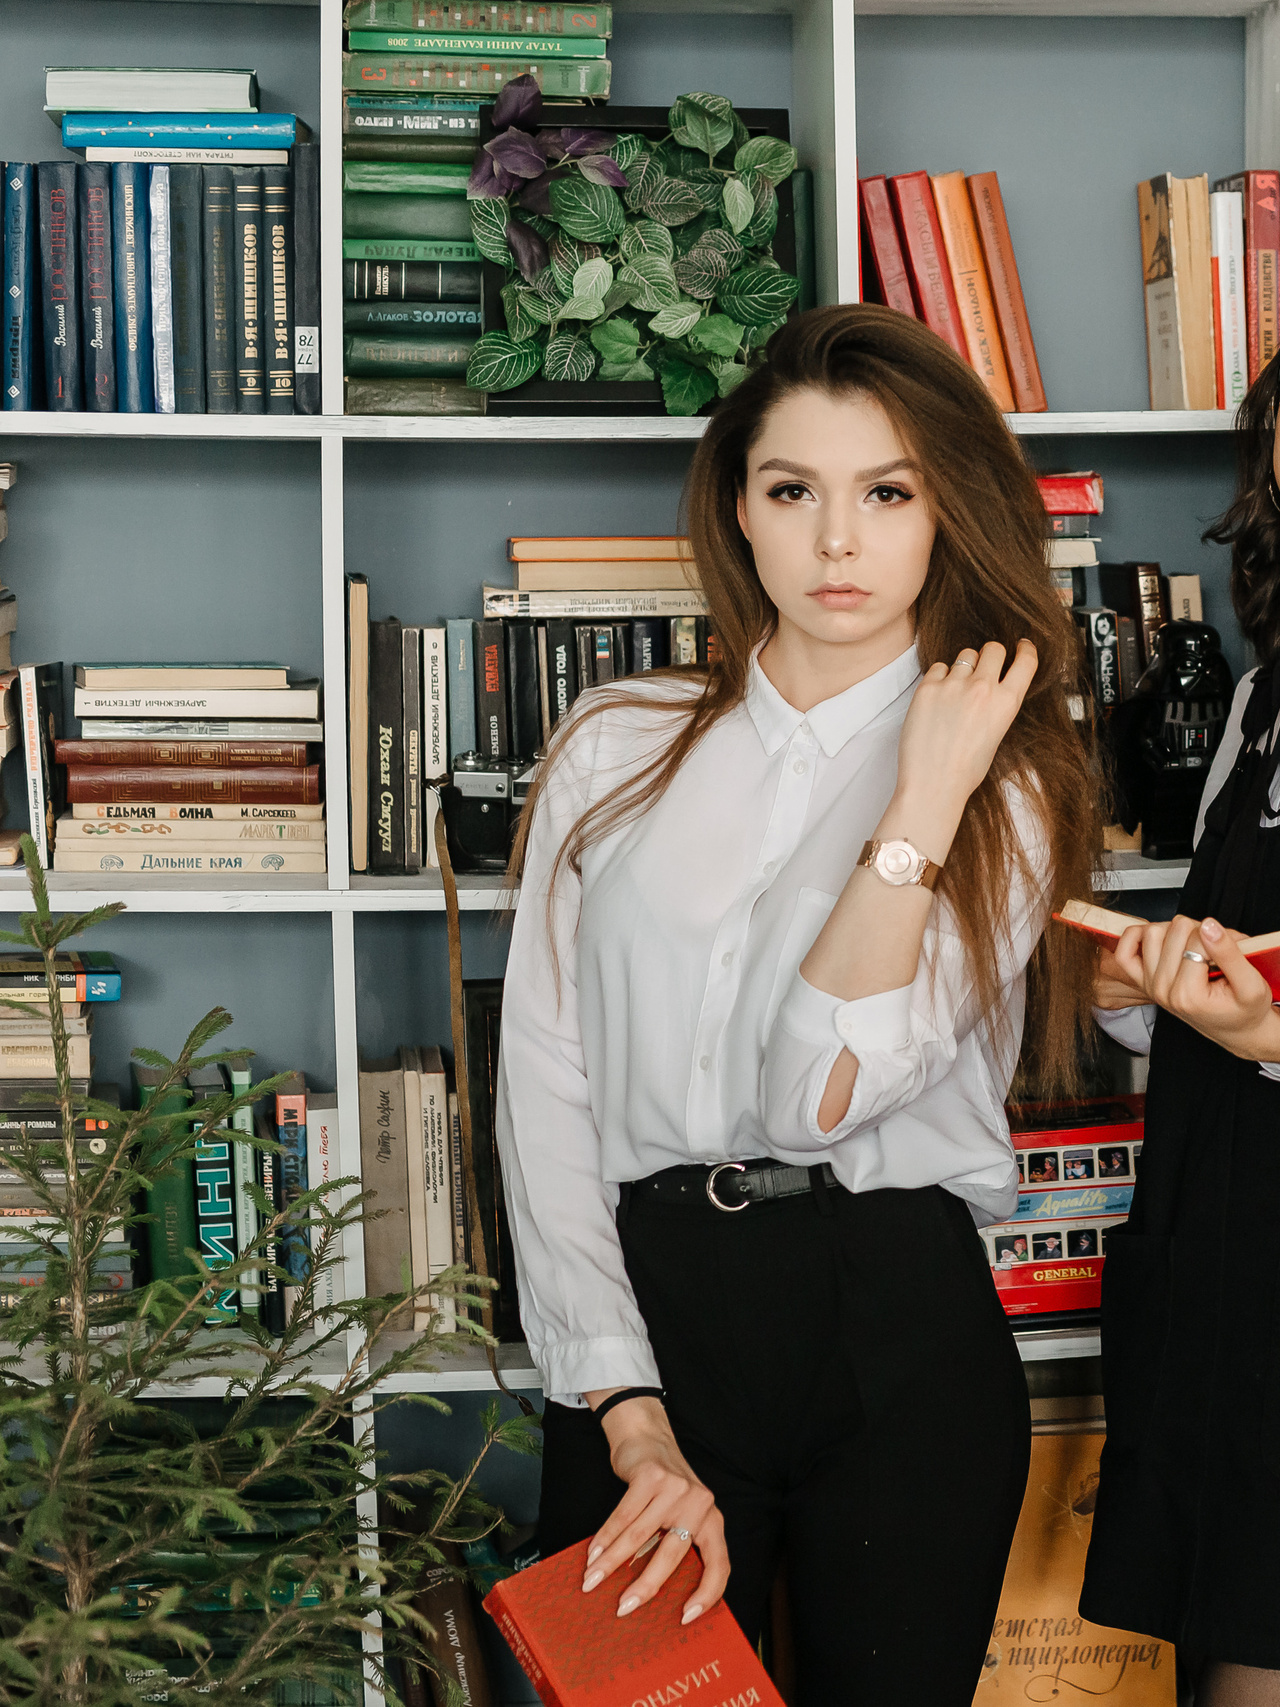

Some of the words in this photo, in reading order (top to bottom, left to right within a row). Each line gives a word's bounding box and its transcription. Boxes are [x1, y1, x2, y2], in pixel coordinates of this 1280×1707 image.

[387, 37, 408, 47] 2008
[414, 38, 483, 50] КАЛЕНДАРЕ
[486, 40, 523, 51] ДИНИ
[526, 41, 562, 52] ТАТАР
[126, 252, 137, 313] ЭДМУНДОВИЧ
[965, 277, 986, 334] ЛОНДОН
[53, 304, 66, 347] Василий
[89, 306, 103, 350] Василий
[127, 315, 138, 352] ФЕЛИКС
[298, 334, 314, 347] 78
[297, 353, 313, 365] 77
[979, 338, 995, 377] ДЖЕК
[275, 377, 291, 388] 10
[556, 644, 567, 675] ГОДА
[431, 655, 440, 701] ДЕТЕКТИВ
[94, 699, 141, 709] ДЕТЕКТИВ
[145, 699, 207, 708] ЗАРУБЕЖНЫЙ
[432, 703, 440, 765] ЗАРУБЕЖНЫЙ
[489, 714, 500, 756] ЕМЕНОВ
[379, 725, 394, 787] Юхан
[96, 806, 156, 819] СЕДЬМАЯ
[169, 806, 214, 820] ВОЛНА
[377, 791, 394, 853] Смуул
[209, 856, 243, 869] КРАЯ
[28, 1121, 56, 1129] РОМАНЫ
[283, 1108, 299, 1149] МЕРИ
[1033, 1266, 1097, 1281] GENERAL
[444, 1609, 461, 1648] ДЮМА
